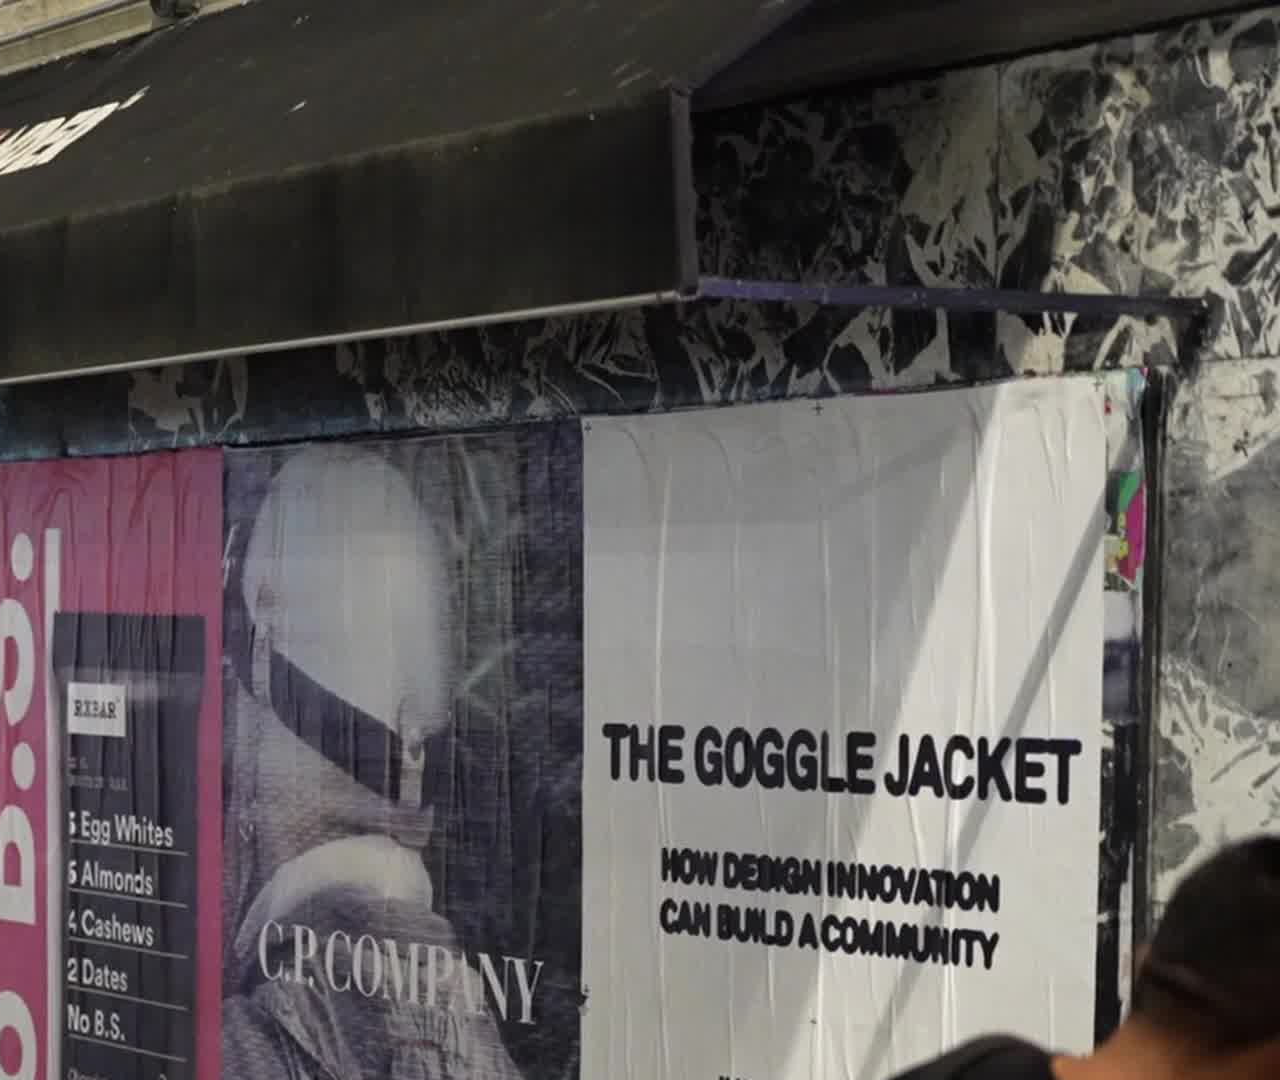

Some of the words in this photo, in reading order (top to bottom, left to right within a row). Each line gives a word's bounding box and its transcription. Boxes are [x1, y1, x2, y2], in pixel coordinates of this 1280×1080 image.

[602, 723, 685, 784] THE
[694, 725, 877, 795] GOGGLE
[884, 734, 1082, 804] JACKET
[81, 810, 111, 846] Egg
[114, 813, 174, 848] Whites
[81, 860, 153, 895] Almonds
[661, 847, 718, 887] HOW
[722, 852, 822, 896] DESIGN
[827, 859, 1001, 914] INNOVATION
[81, 909, 154, 947] Cashews
[660, 898, 712, 938] CAN
[716, 903, 794, 946] BUILD
[798, 912, 819, 950] A
[820, 914, 1001, 970] COMMUNITY
[67, 958, 78, 982] 2
[81, 957, 128, 992] Dates
[325, 930, 544, 1025] COMPANY
[66, 1003, 90, 1034] No
[94, 1008, 126, 1041] B.S.
